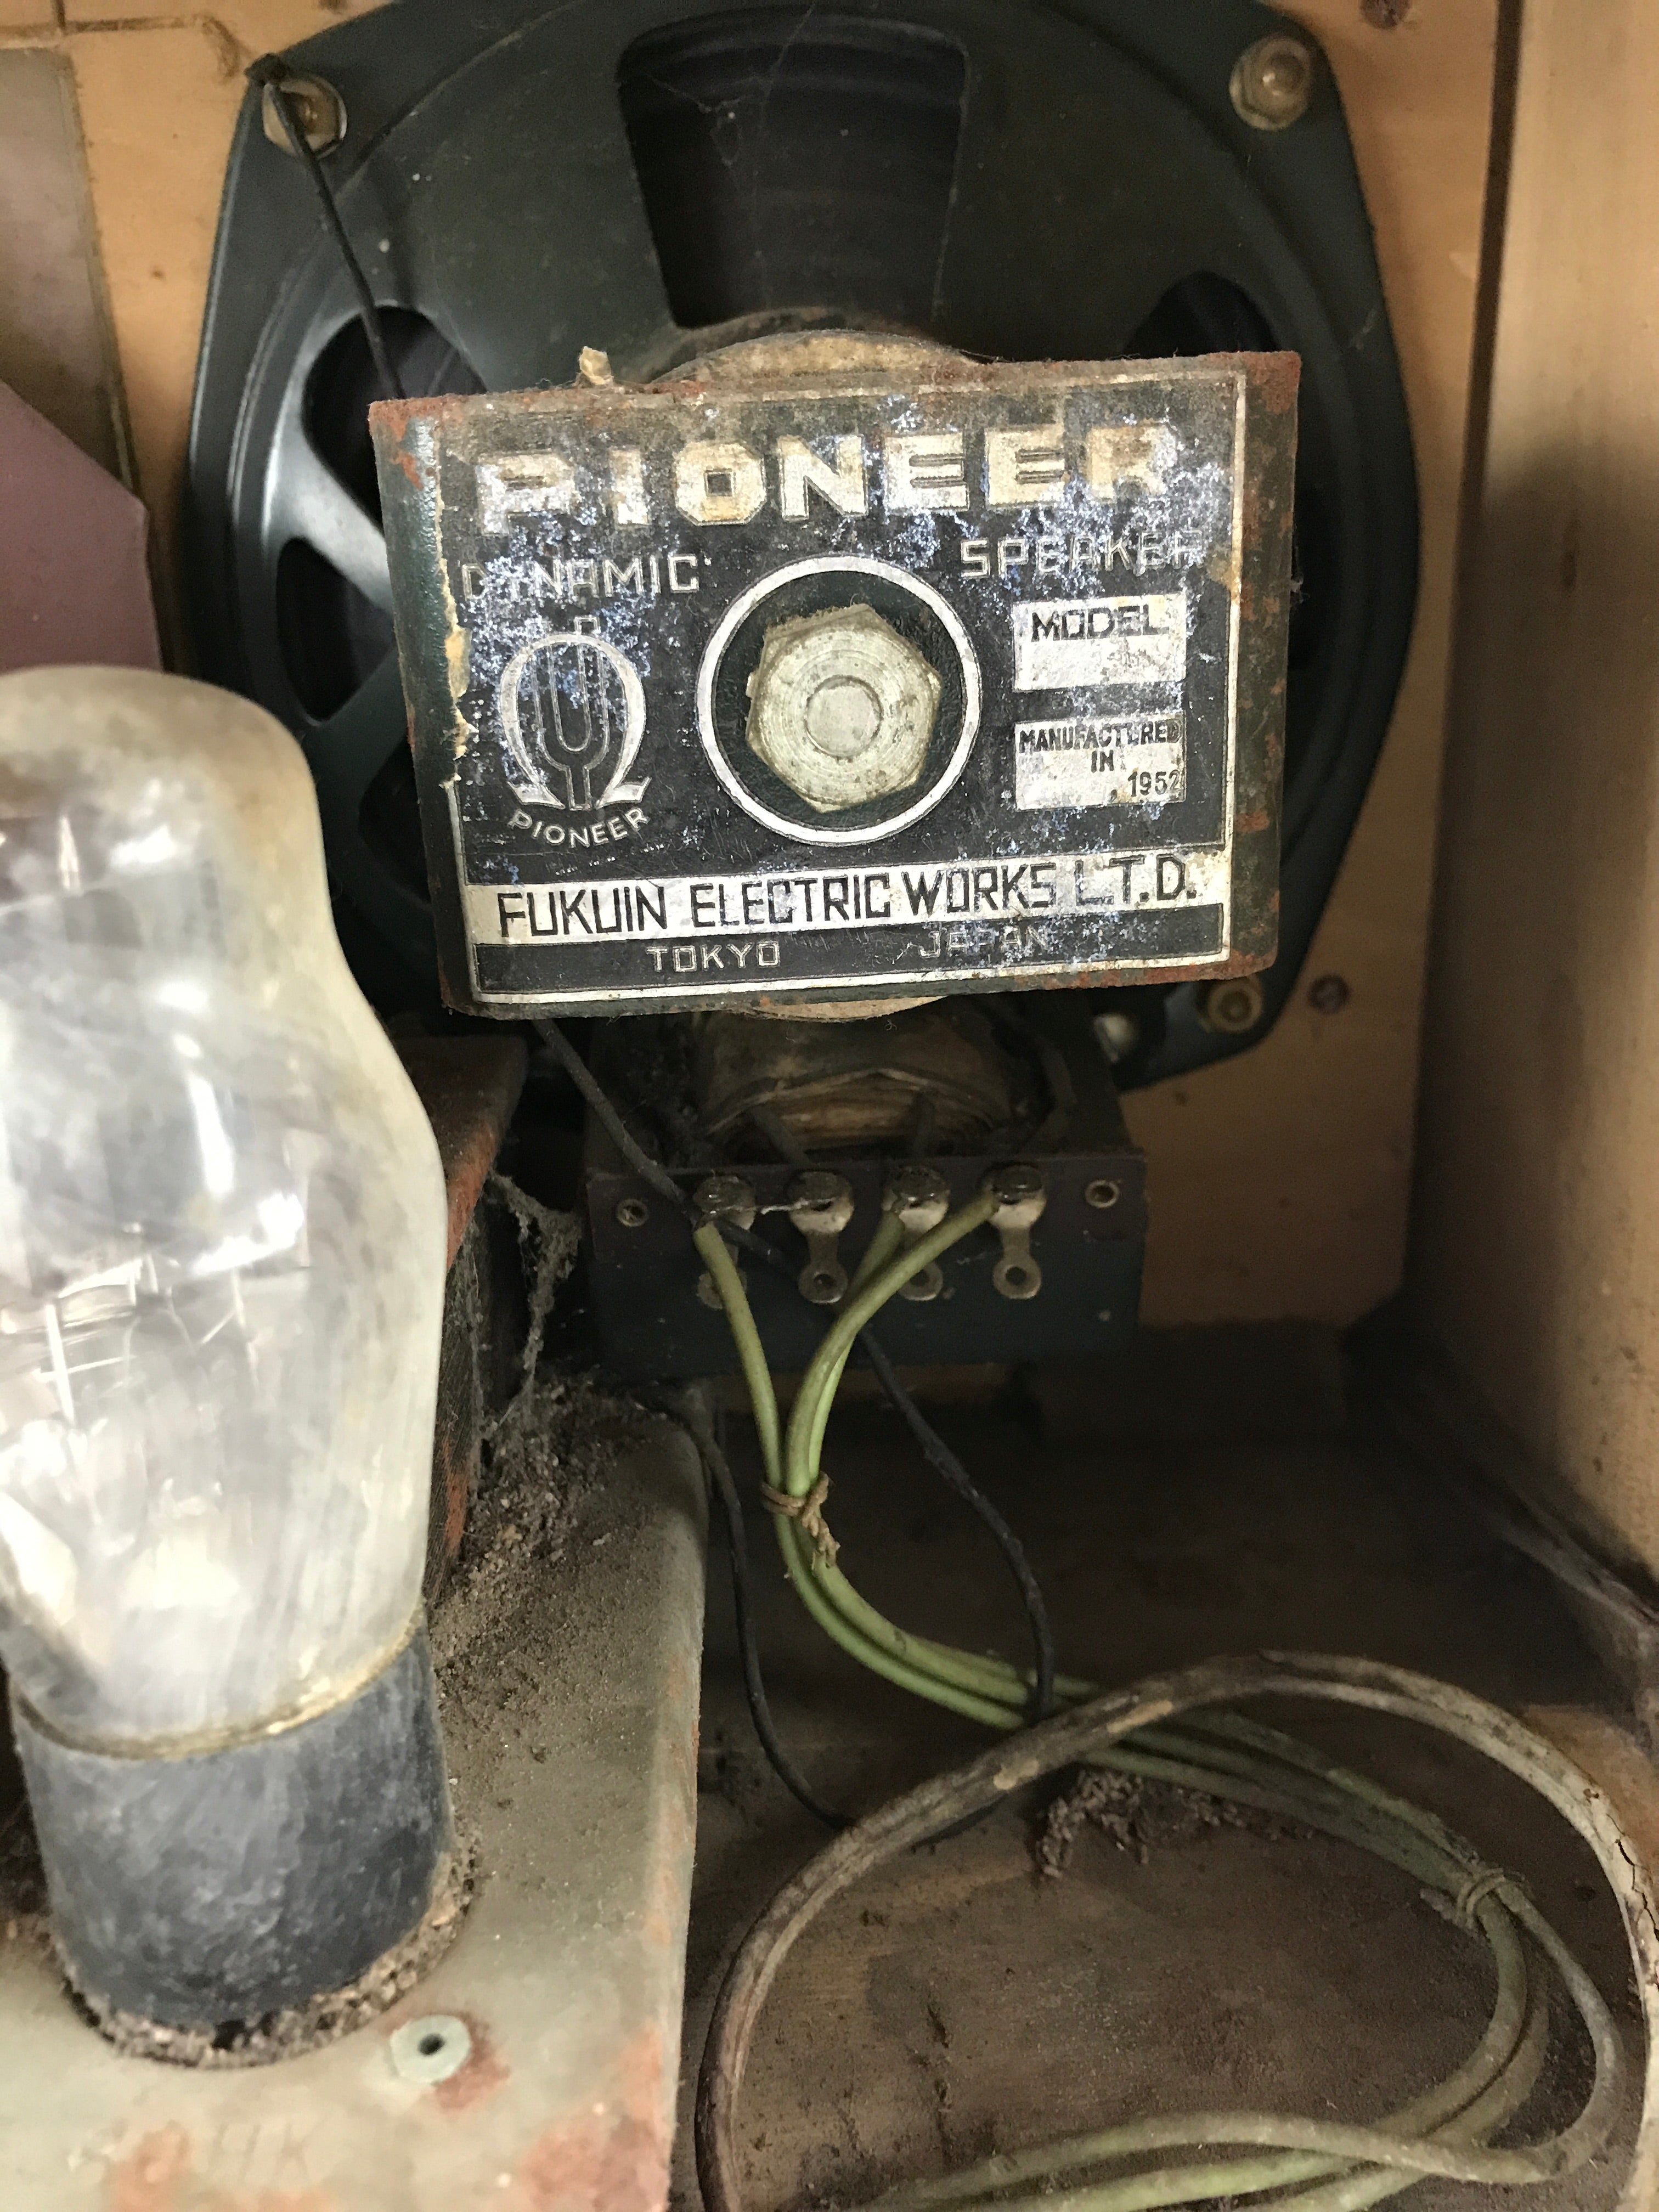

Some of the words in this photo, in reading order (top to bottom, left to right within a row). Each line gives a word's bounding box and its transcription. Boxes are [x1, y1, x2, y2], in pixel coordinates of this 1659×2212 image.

[474, 424, 1177, 538] PIONEER
[960, 529, 1205, 579] SPEAKER
[1031, 603, 1170, 642] MODEL
[1019, 718, 1183, 754] MANUFACTURED
[1091, 750, 1114, 773] IN
[508, 807, 650, 848] PIONEER
[497, 887, 668, 937] FUKUIN
[690, 873, 890, 928] ELECTRIC
[901, 862, 1056, 916] WORKS
[646, 940, 781, 973] TOKYO
[918, 927, 1051, 959] JAPAN
